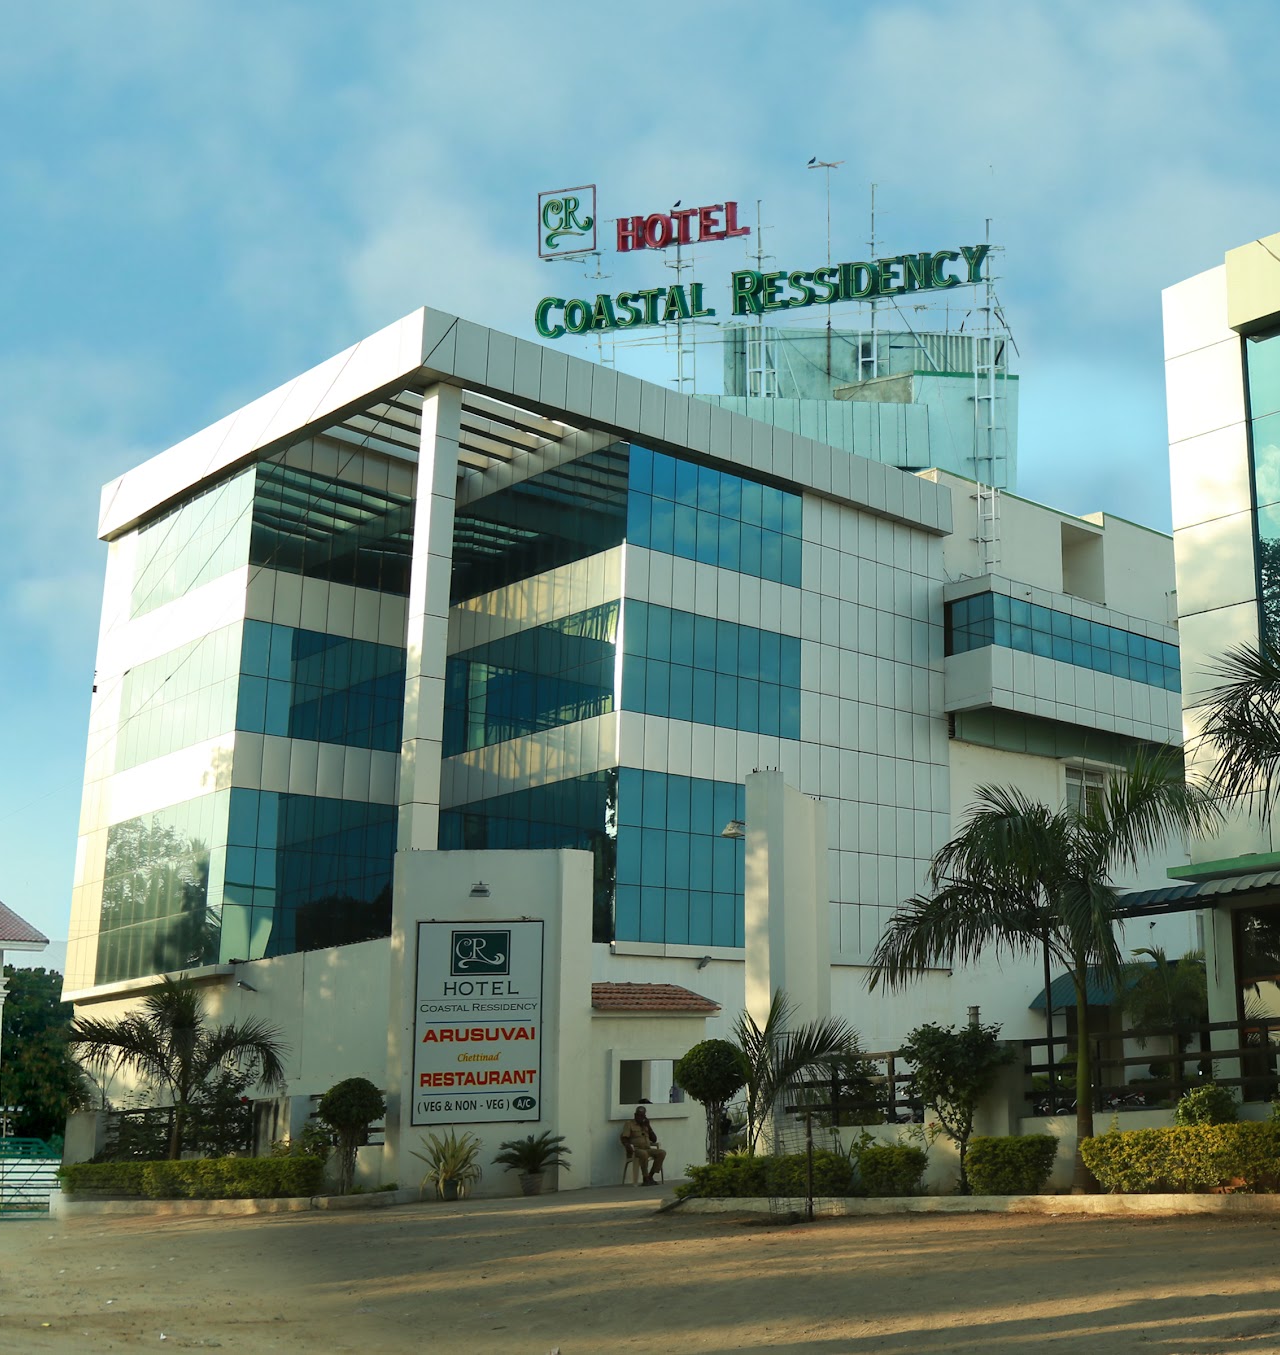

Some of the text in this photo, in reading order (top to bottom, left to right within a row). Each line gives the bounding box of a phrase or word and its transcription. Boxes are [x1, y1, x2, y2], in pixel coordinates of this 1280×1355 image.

[617, 201, 750, 252] HOTEL
[535, 244, 992, 338] COASTAL RESSIDENCY
[444, 981, 519, 996] HOTEL
[420, 1003, 538, 1013] COASTAL RESSIDENCY
[423, 1027, 535, 1043] ARUSUVAI
[457, 1052, 502, 1062] Chettinad
[420, 1070, 536, 1087] RESTAURANT
[424, 1101, 442, 1112] VEG
[444, 1101, 453, 1111] &
[455, 1100, 477, 1110] NON
[486, 1099, 504, 1110] VEG
[517, 1099, 531, 1109] A/C
